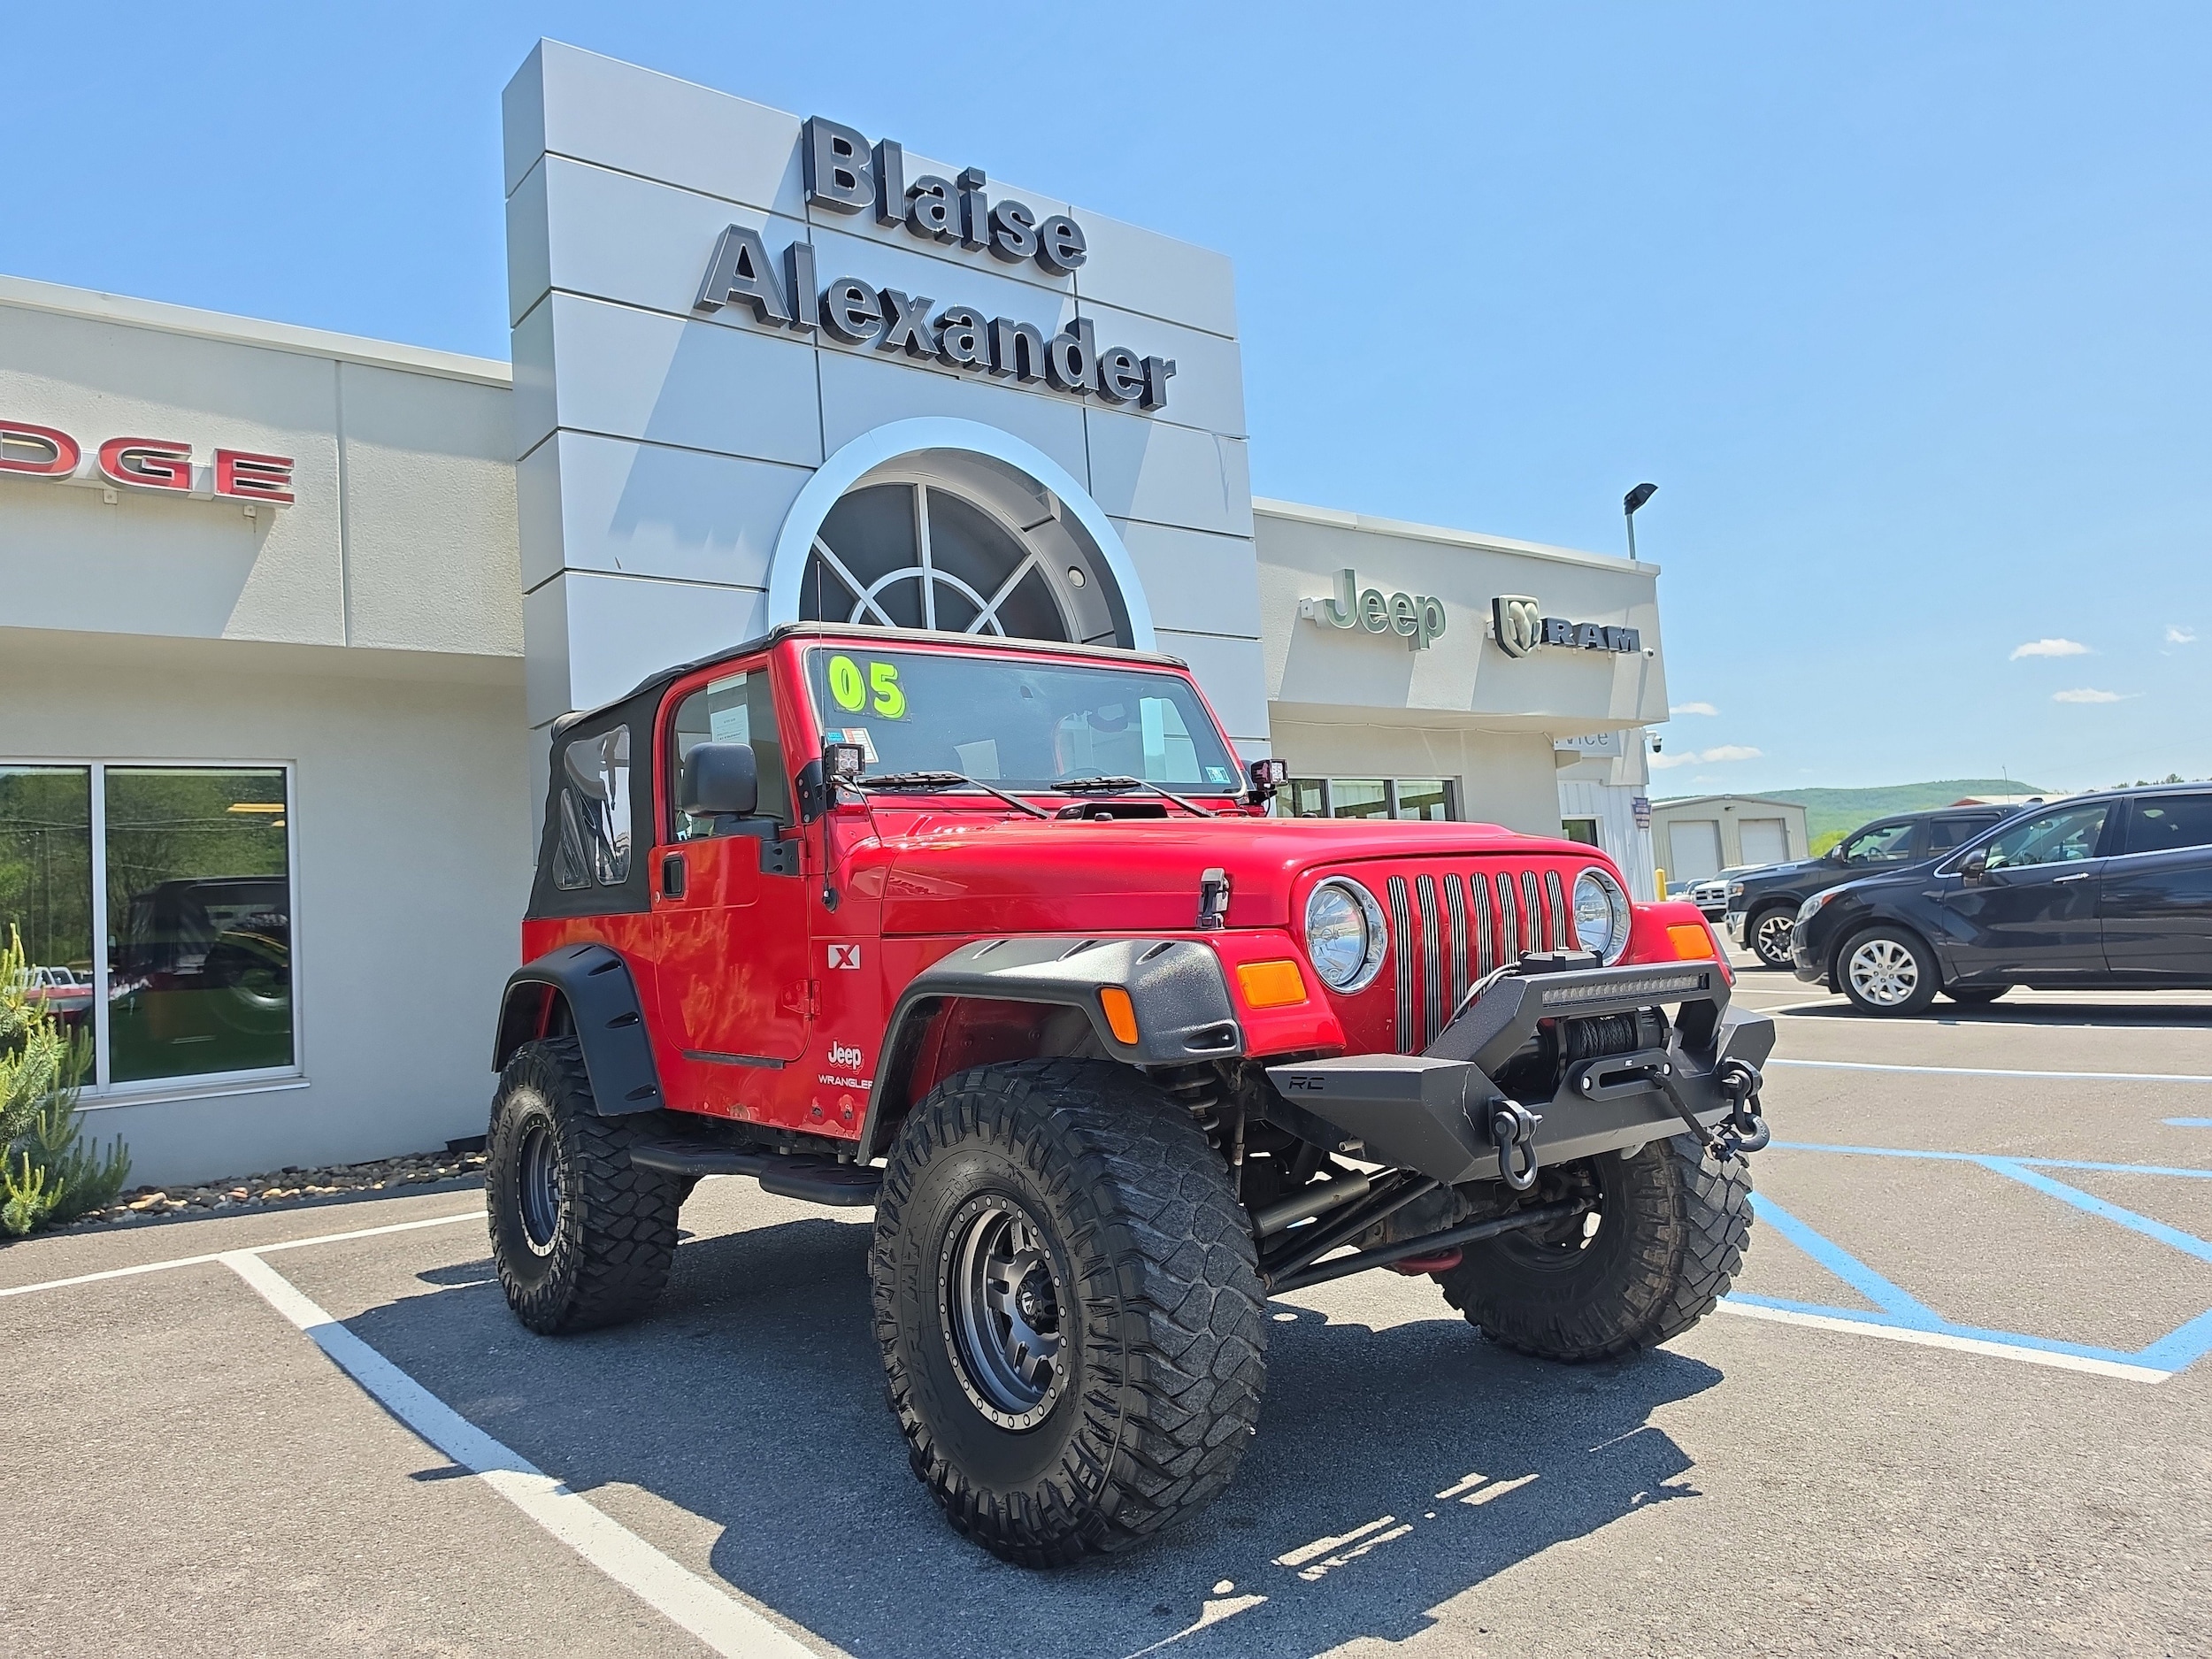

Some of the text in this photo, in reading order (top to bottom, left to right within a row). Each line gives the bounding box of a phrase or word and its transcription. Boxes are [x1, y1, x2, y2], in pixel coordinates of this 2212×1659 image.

[803, 115, 1087, 276] Blaise
[693, 223, 1177, 411] Alexander
[1325, 569, 1446, 651] Jeep
[1541, 618, 1640, 652] RAM
[829, 655, 906, 718] 05
[830, 944, 860, 969] X
[828, 1041, 862, 1070] Jeep
[1288, 1076, 1325, 1090] RC
